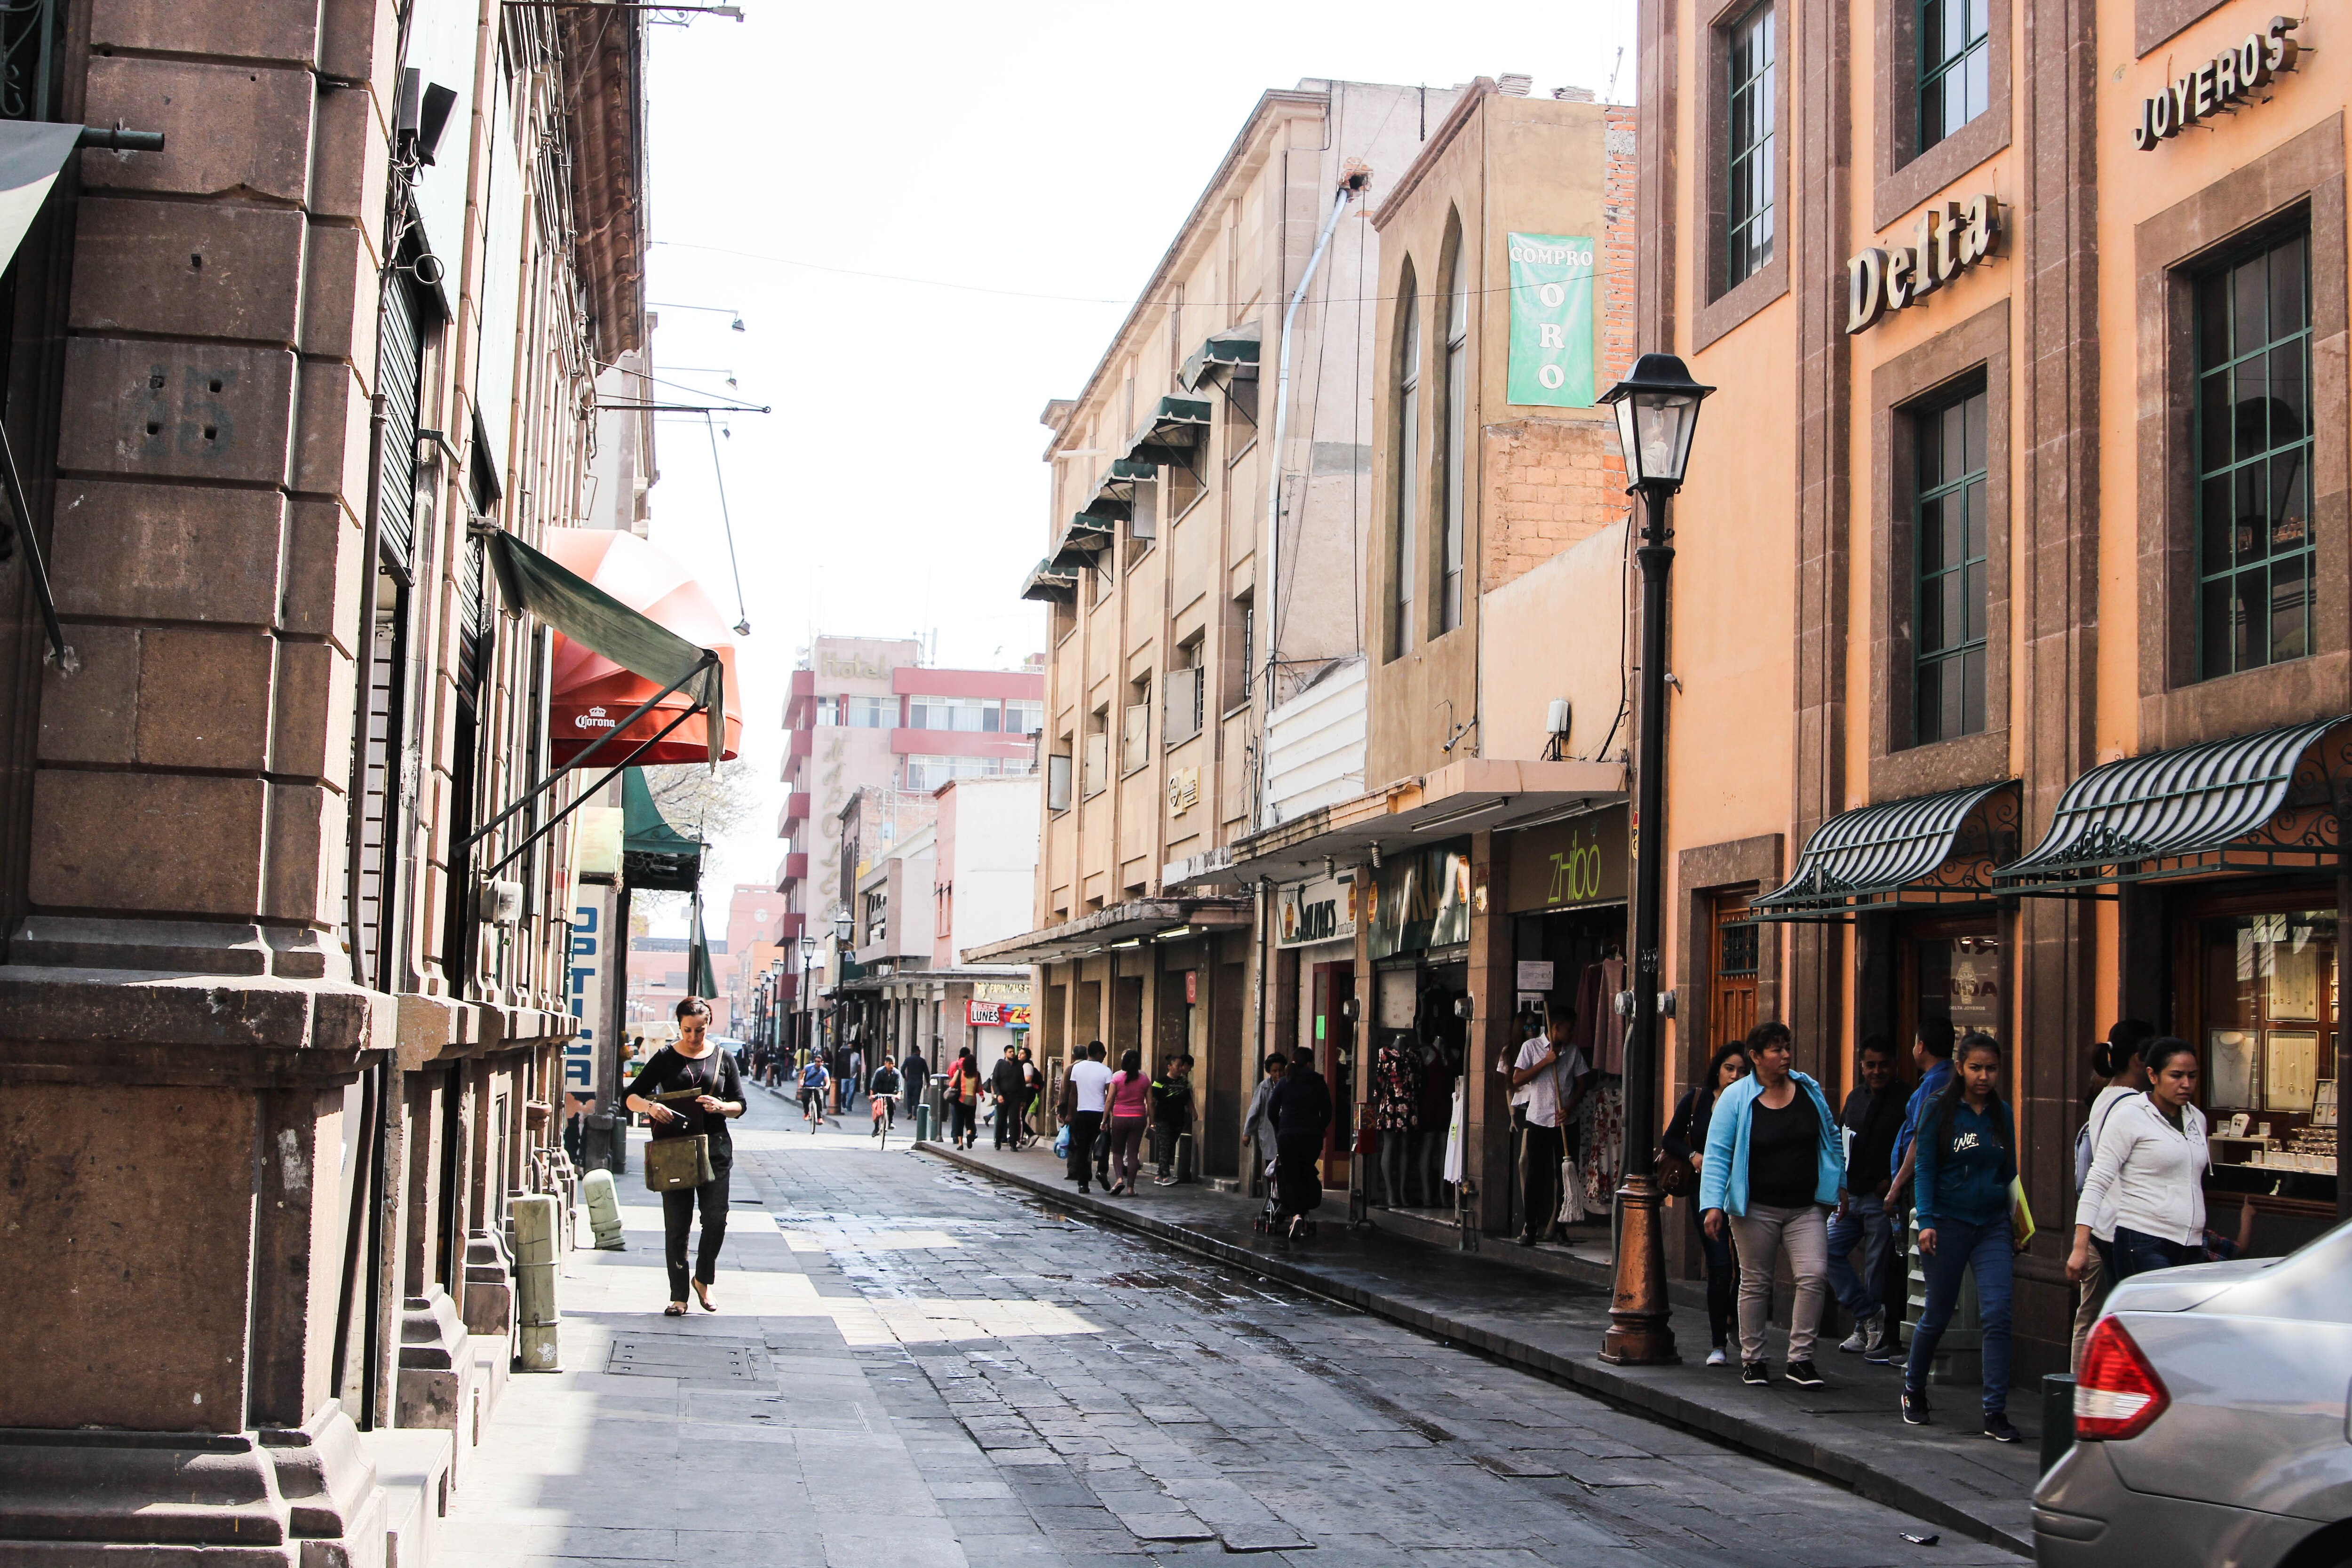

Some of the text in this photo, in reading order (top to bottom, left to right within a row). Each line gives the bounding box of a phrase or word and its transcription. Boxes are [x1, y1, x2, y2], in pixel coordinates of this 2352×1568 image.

[2131, 16, 2297, 151] JOYEROS
[1509, 247, 1594, 267] COMPRO
[1845, 193, 2000, 334] Delta
[1539, 282, 1565, 390] ORO
[821, 651, 890, 680] Hotel
[575, 715, 615, 729] Corona
[565, 907, 597, 1086] OPTICA
[972, 1011, 1000, 1022] LUNES
